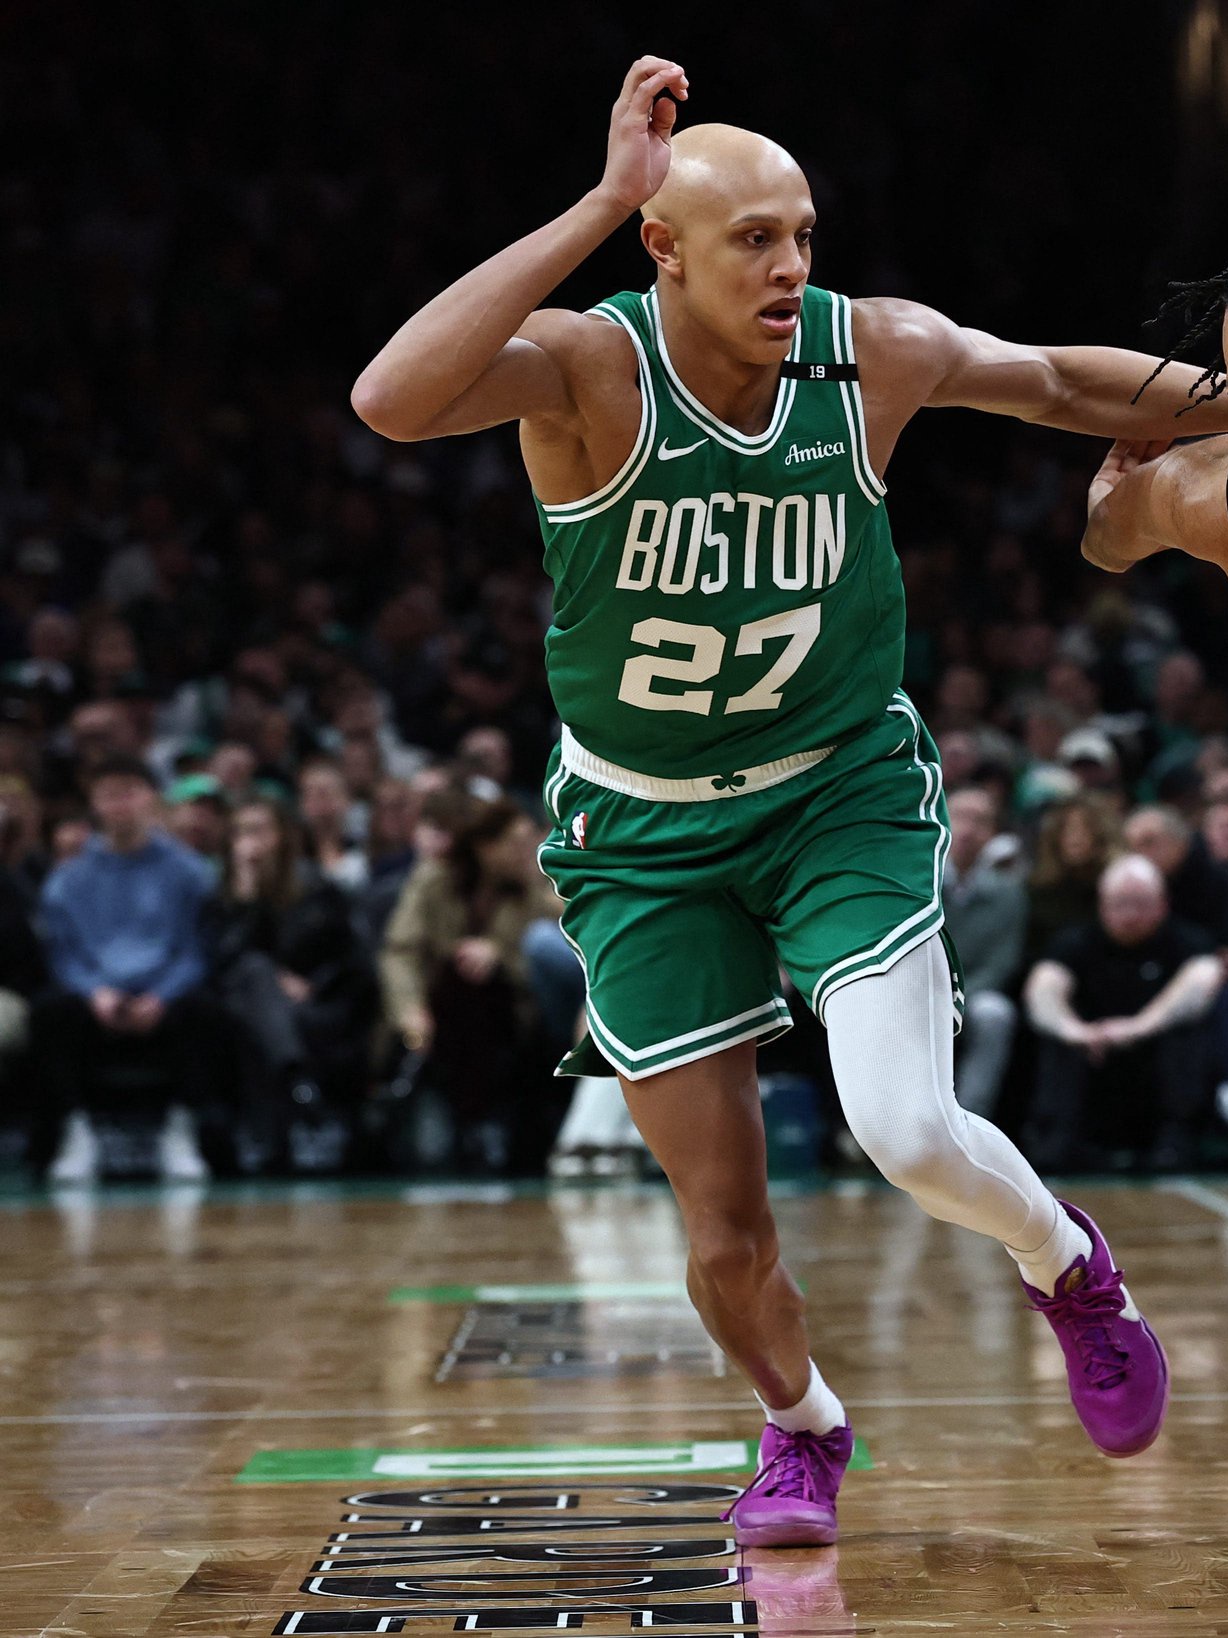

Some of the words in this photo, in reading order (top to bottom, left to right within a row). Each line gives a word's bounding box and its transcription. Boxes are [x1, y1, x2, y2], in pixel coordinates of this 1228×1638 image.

[809, 365, 826, 379] 19
[784, 440, 846, 466] Amica
[615, 492, 846, 595] BOSTON
[617, 602, 822, 717] 27
[272, 1481, 759, 1638] GARDE
